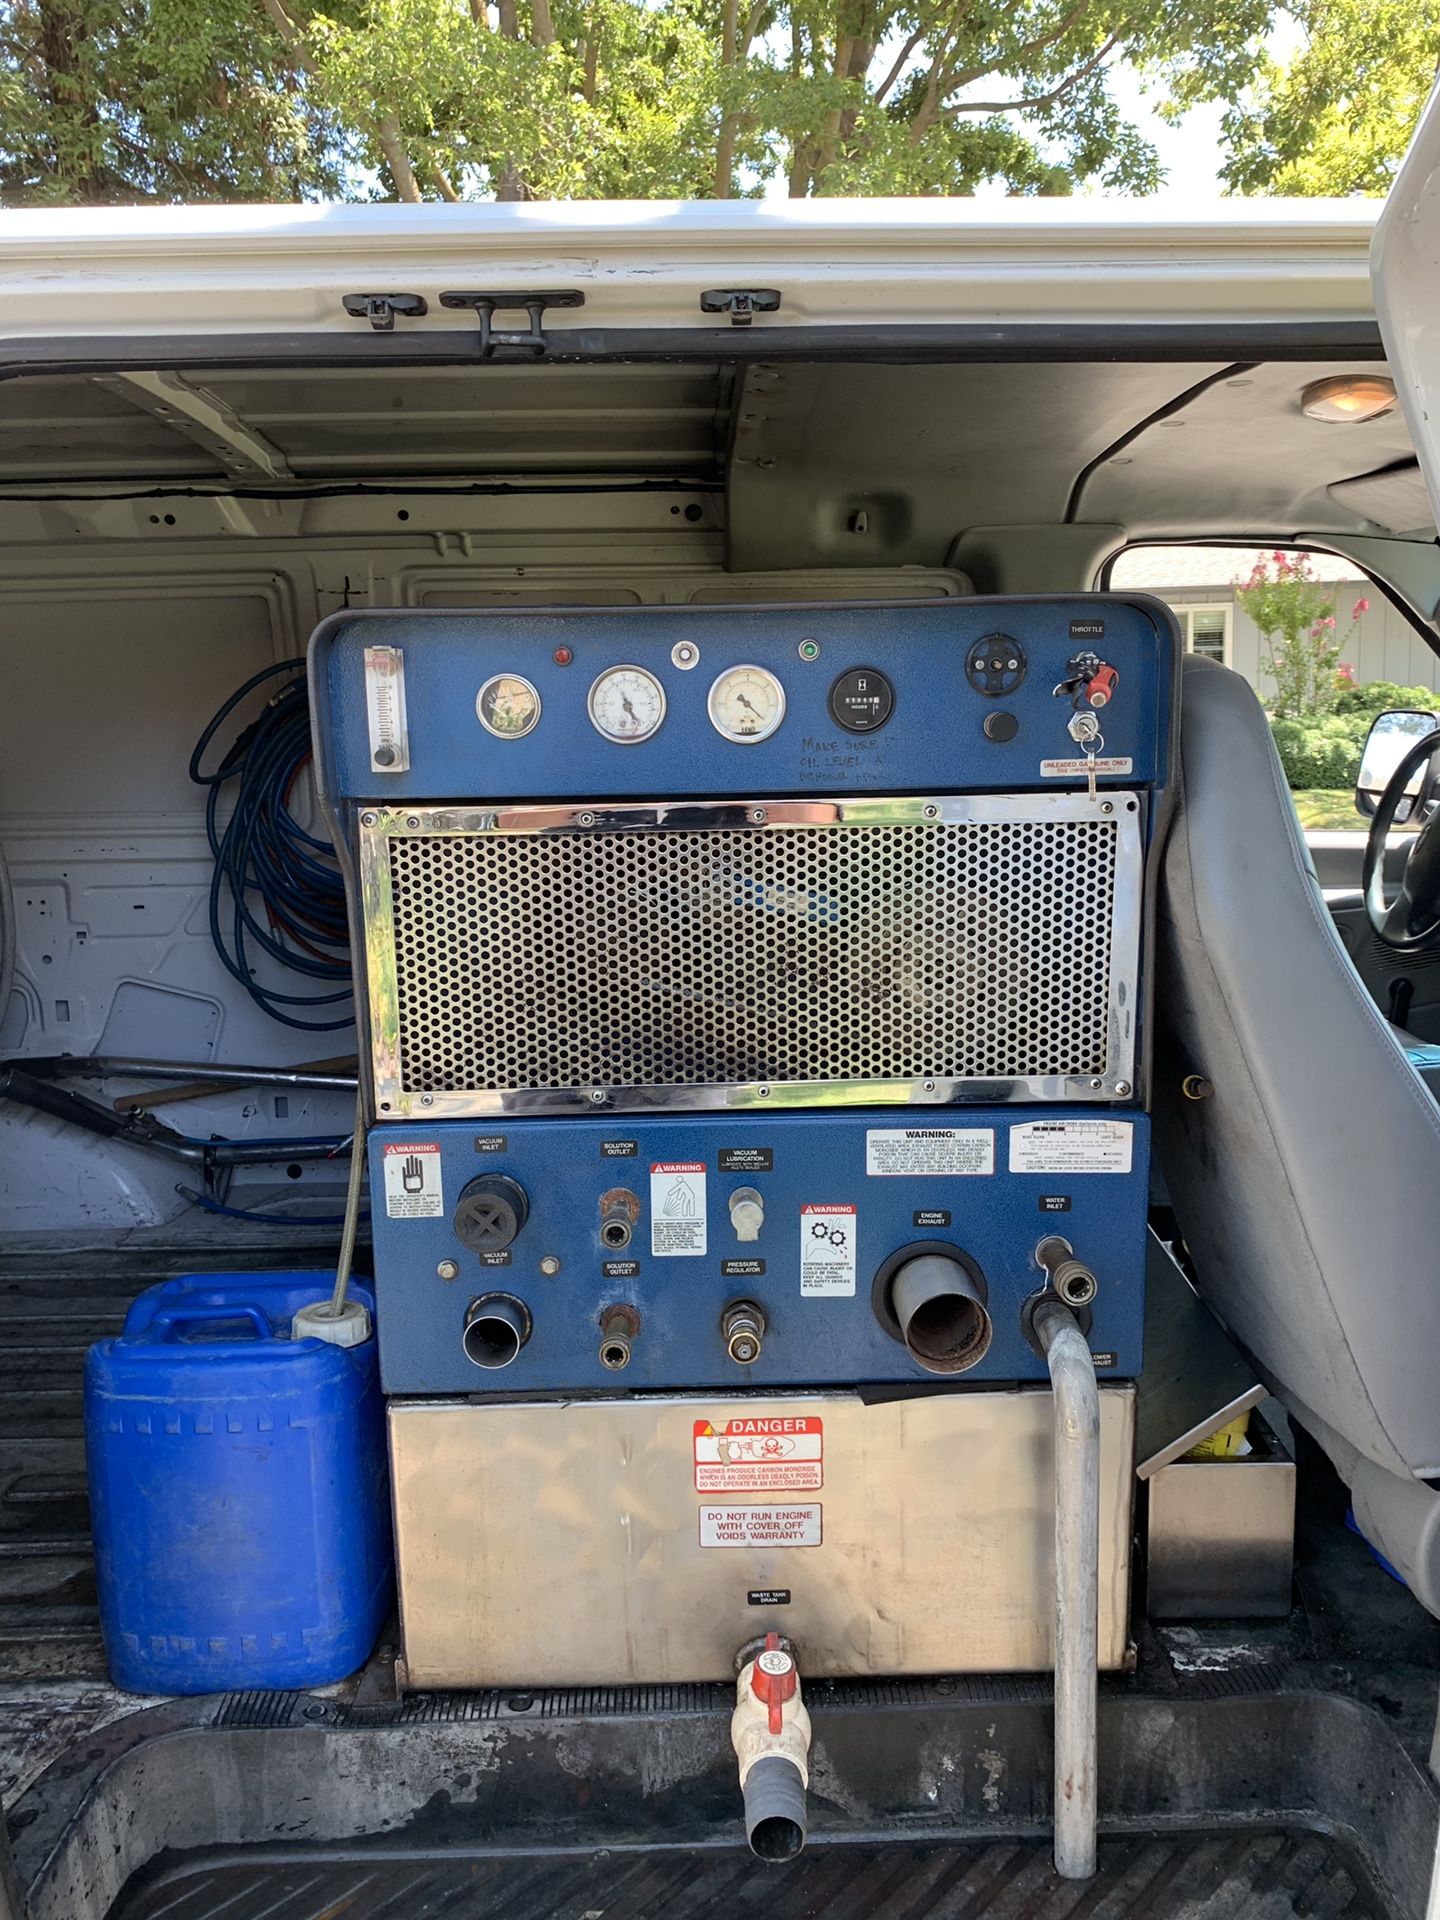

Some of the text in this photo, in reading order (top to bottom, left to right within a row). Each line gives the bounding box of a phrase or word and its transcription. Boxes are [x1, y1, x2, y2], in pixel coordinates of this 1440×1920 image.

[732, 1419, 806, 1433] DANGER
[776, 1511, 813, 1520] ENGINE
[750, 1532, 805, 1540] WARRANTY
